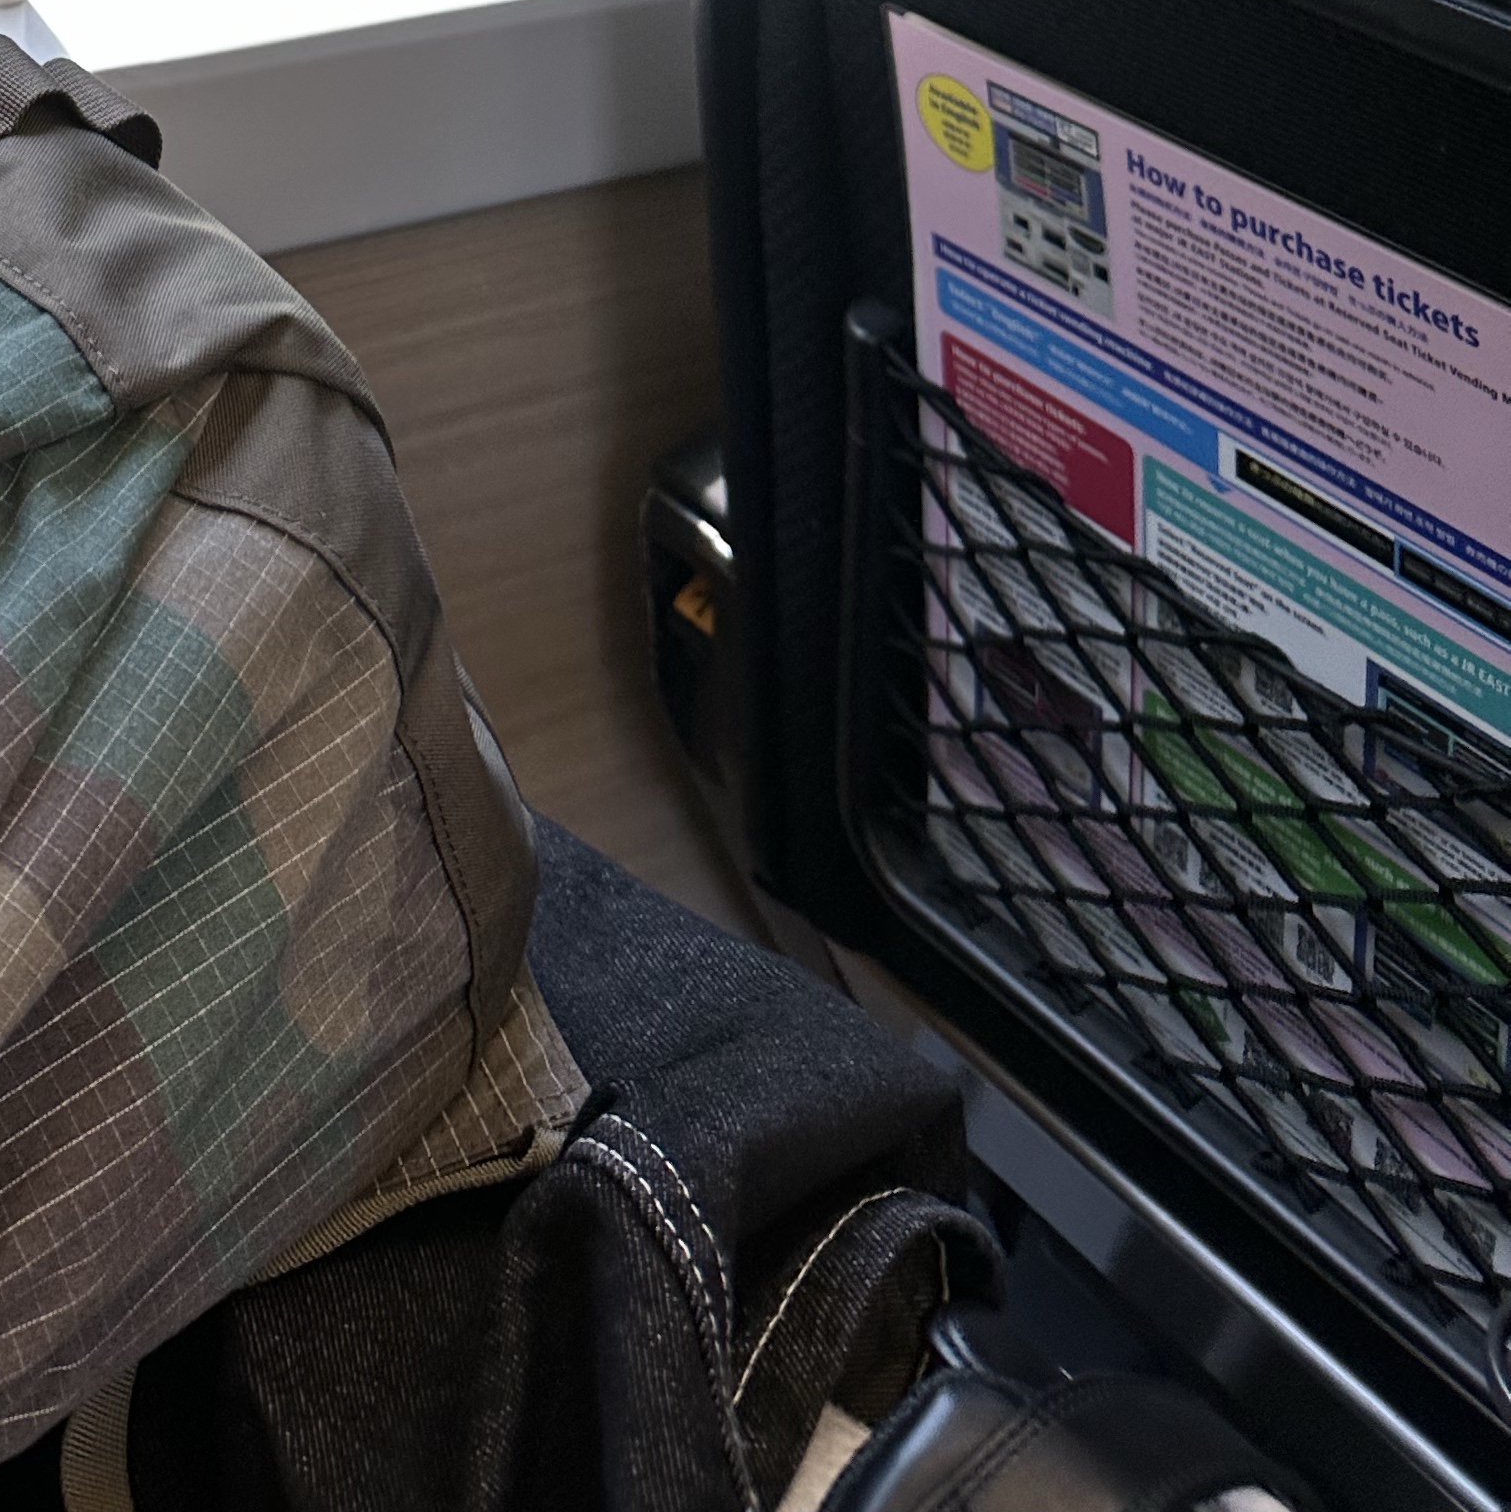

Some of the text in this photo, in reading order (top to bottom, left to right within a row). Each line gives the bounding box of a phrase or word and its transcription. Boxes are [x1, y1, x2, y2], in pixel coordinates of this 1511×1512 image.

[1126, 149, 1185, 197] How
[1193, 185, 1222, 216] to
[1230, 207, 1364, 288] purchase
[1373, 275, 1479, 347] tickets
[1328, 301, 1379, 335] Reserved
[1382, 329, 1408, 350] Seat
[1411, 344, 1446, 370] Ticket
[1449, 364, 1497, 400] Vending
[1403, 625, 1433, 648] such
[1461, 658, 1475, 675] JR
[1478, 668, 1511, 698] EAST
